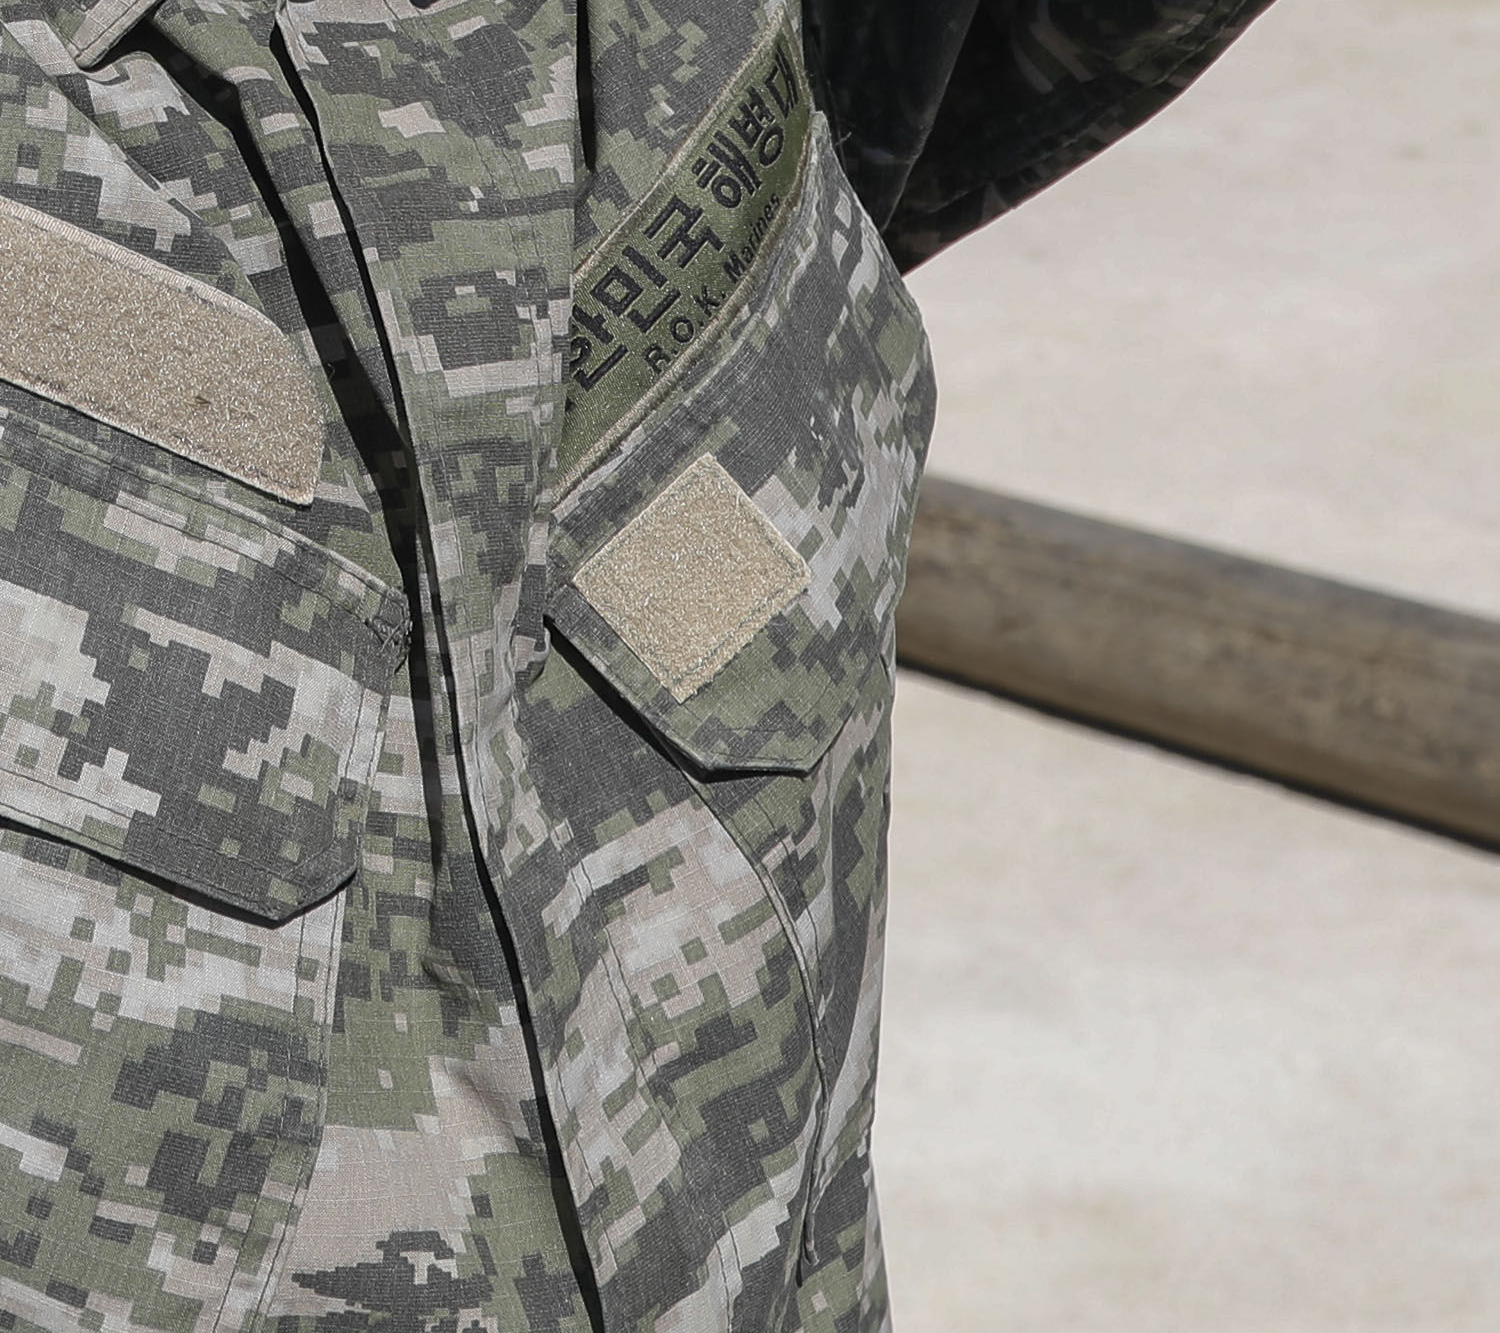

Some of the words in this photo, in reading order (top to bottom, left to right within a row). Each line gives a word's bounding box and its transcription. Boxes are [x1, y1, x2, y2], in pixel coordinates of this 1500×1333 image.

[565, 196, 725, 409] 한민국
[692, 44, 798, 209] 해병대
[645, 285, 727, 374] R.O.K.
[722, 192, 781, 284] Marines
